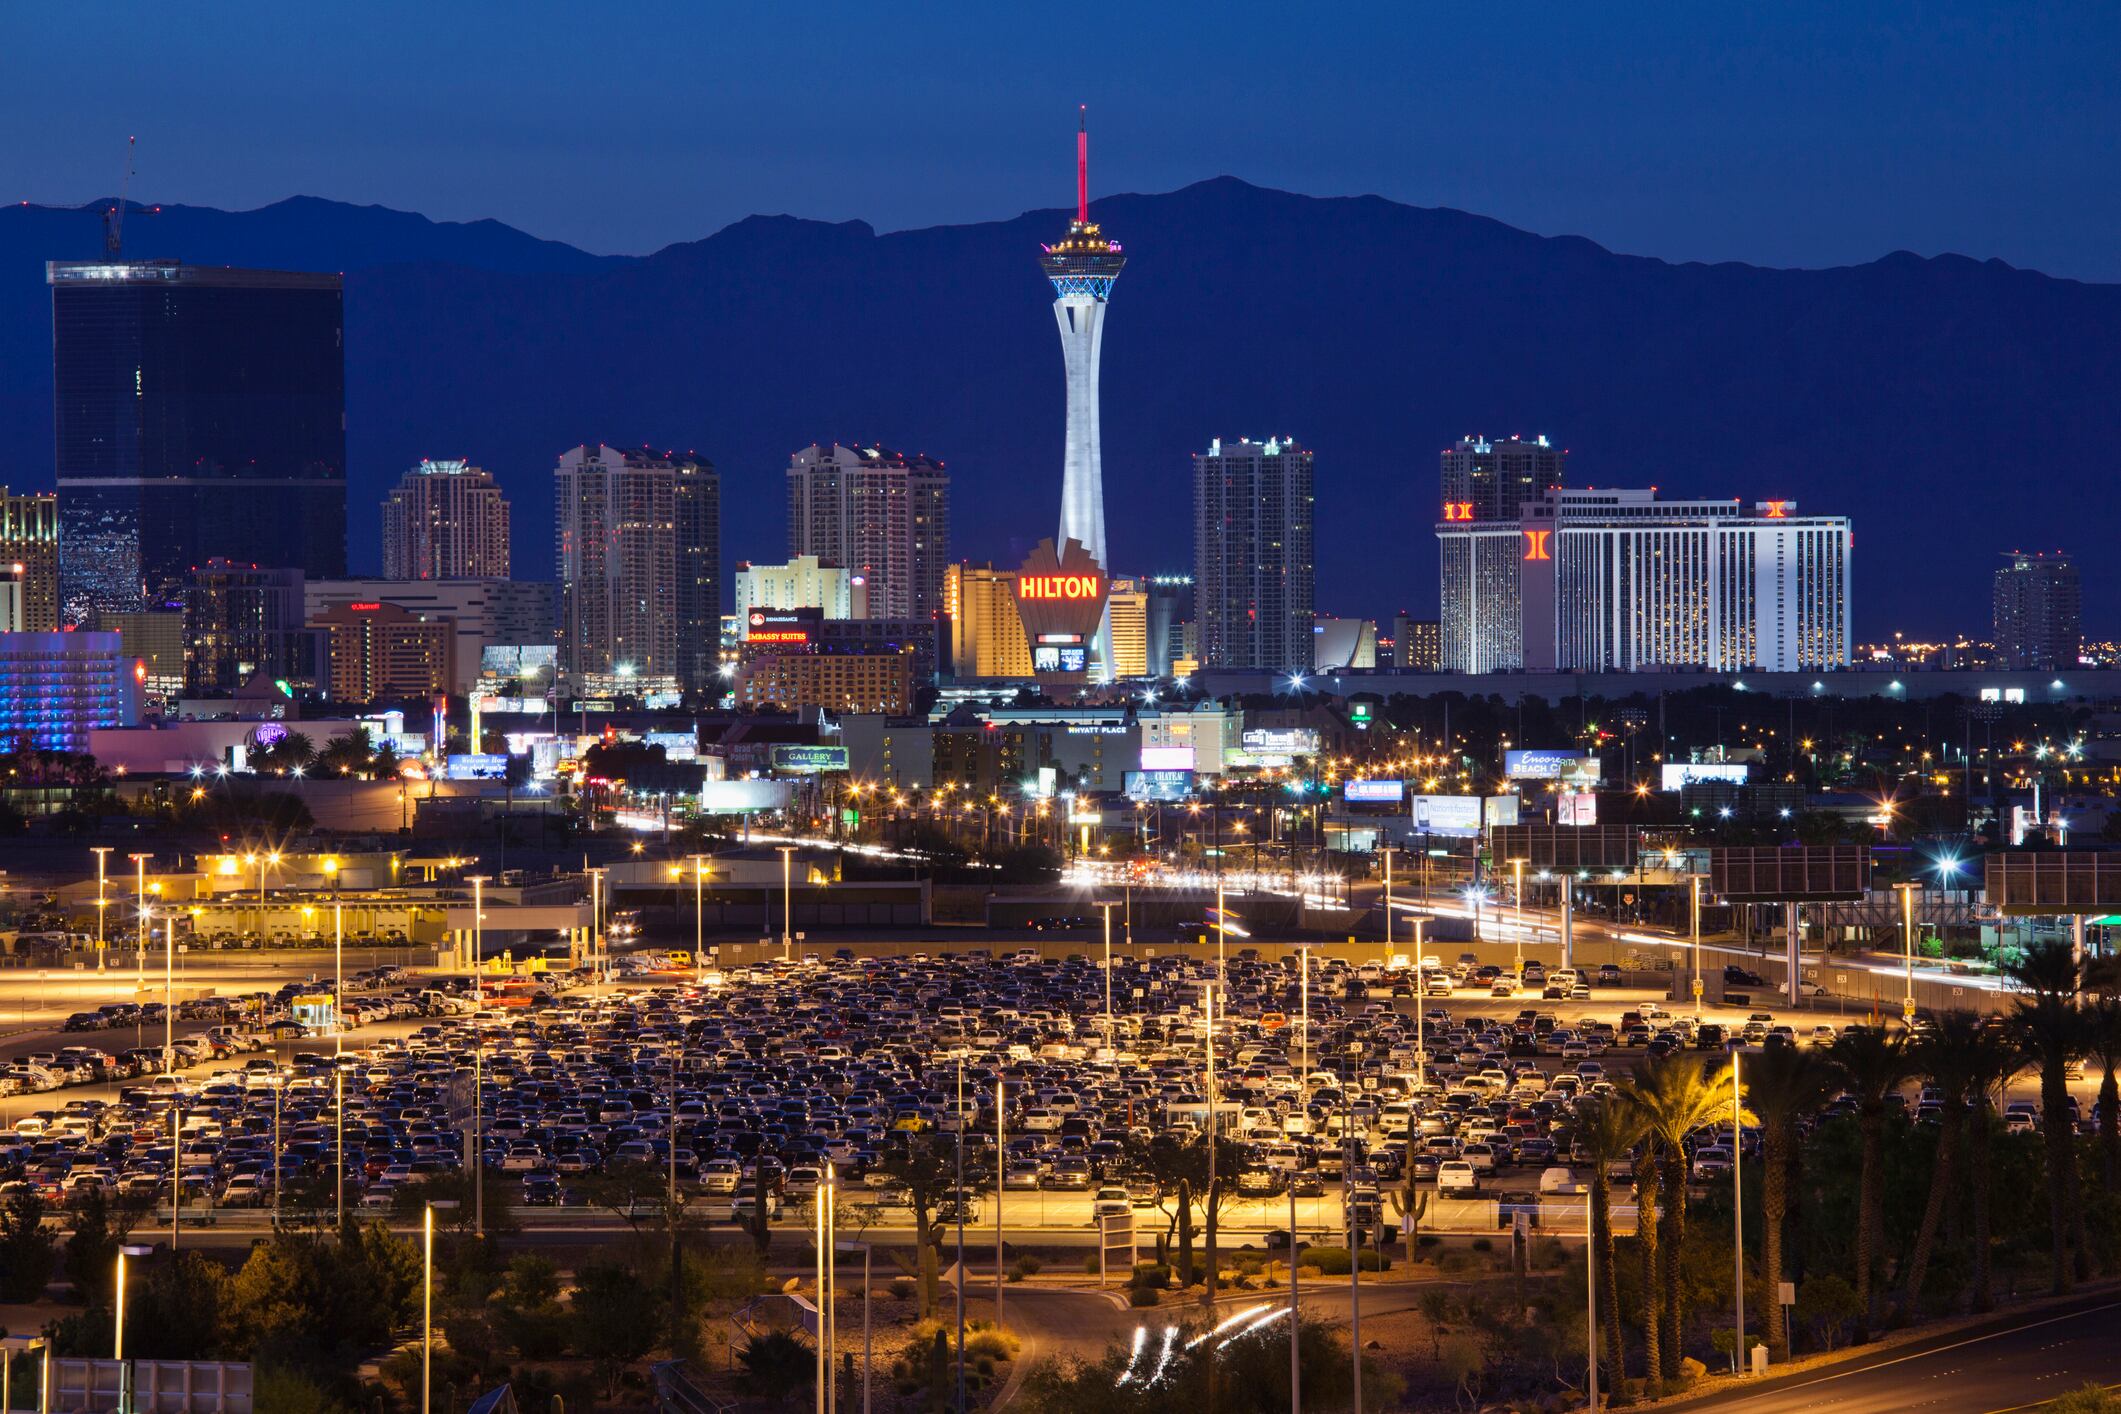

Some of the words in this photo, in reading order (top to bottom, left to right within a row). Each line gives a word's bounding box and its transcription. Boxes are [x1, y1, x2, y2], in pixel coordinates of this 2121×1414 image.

[1020, 576, 1098, 598] HILTON
[1520, 750, 1561, 764] Encore
[1513, 764, 1548, 772] BEACH
[1155, 771, 1184, 780] CHATEAU
